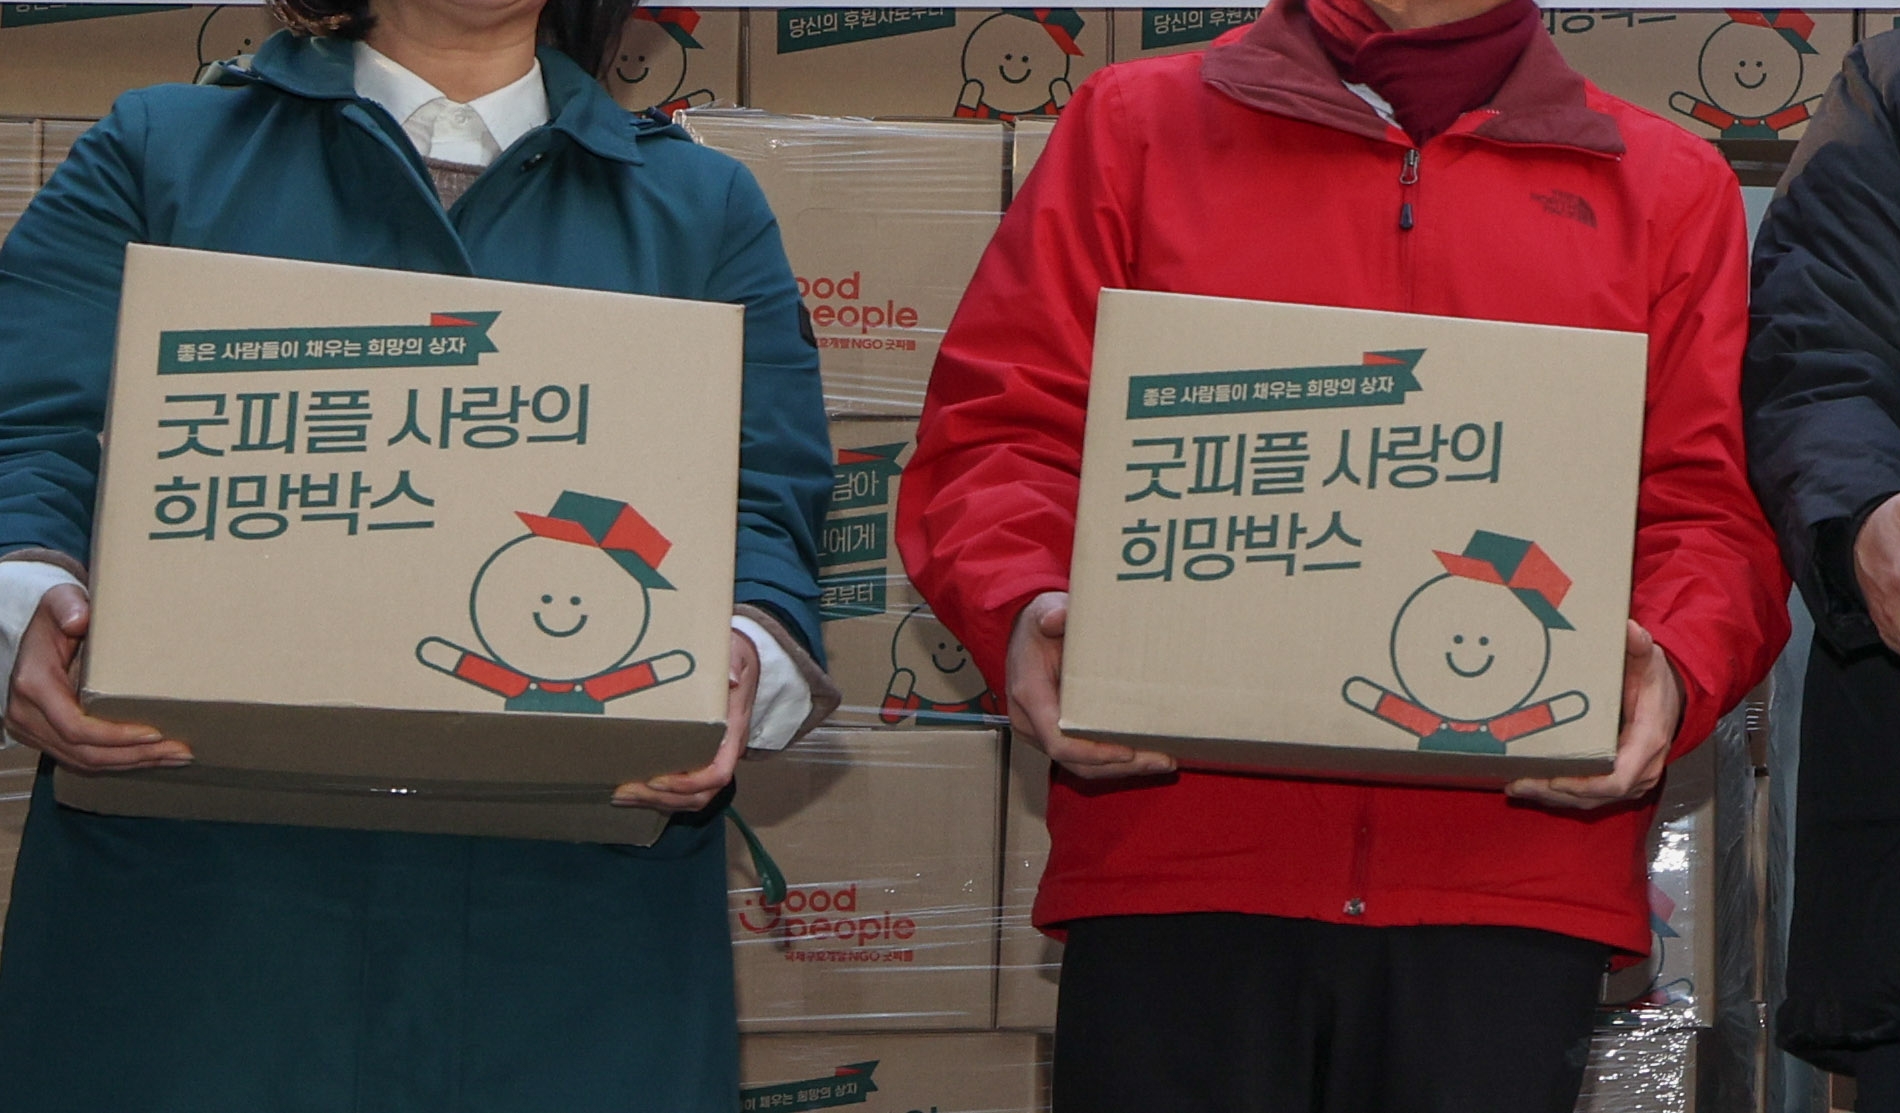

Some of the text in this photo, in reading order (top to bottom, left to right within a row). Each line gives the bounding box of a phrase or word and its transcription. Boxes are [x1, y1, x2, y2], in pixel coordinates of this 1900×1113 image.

[795, 271, 860, 300] ood
[812, 299, 918, 334] eople
[177, 336, 467, 363] 좋은 사람들이 채우는 희망의 상자
[1143, 375, 1395, 407] 좋은 사람들이 채우는 희망의 상자
[158, 384, 589, 459] 굿피플 사랑의
[1125, 422, 1503, 502] 굿피플 사랑의
[149, 471, 434, 541] 희망박스
[1117, 512, 1362, 581] 희망박스
[784, 910, 917, 948] people
